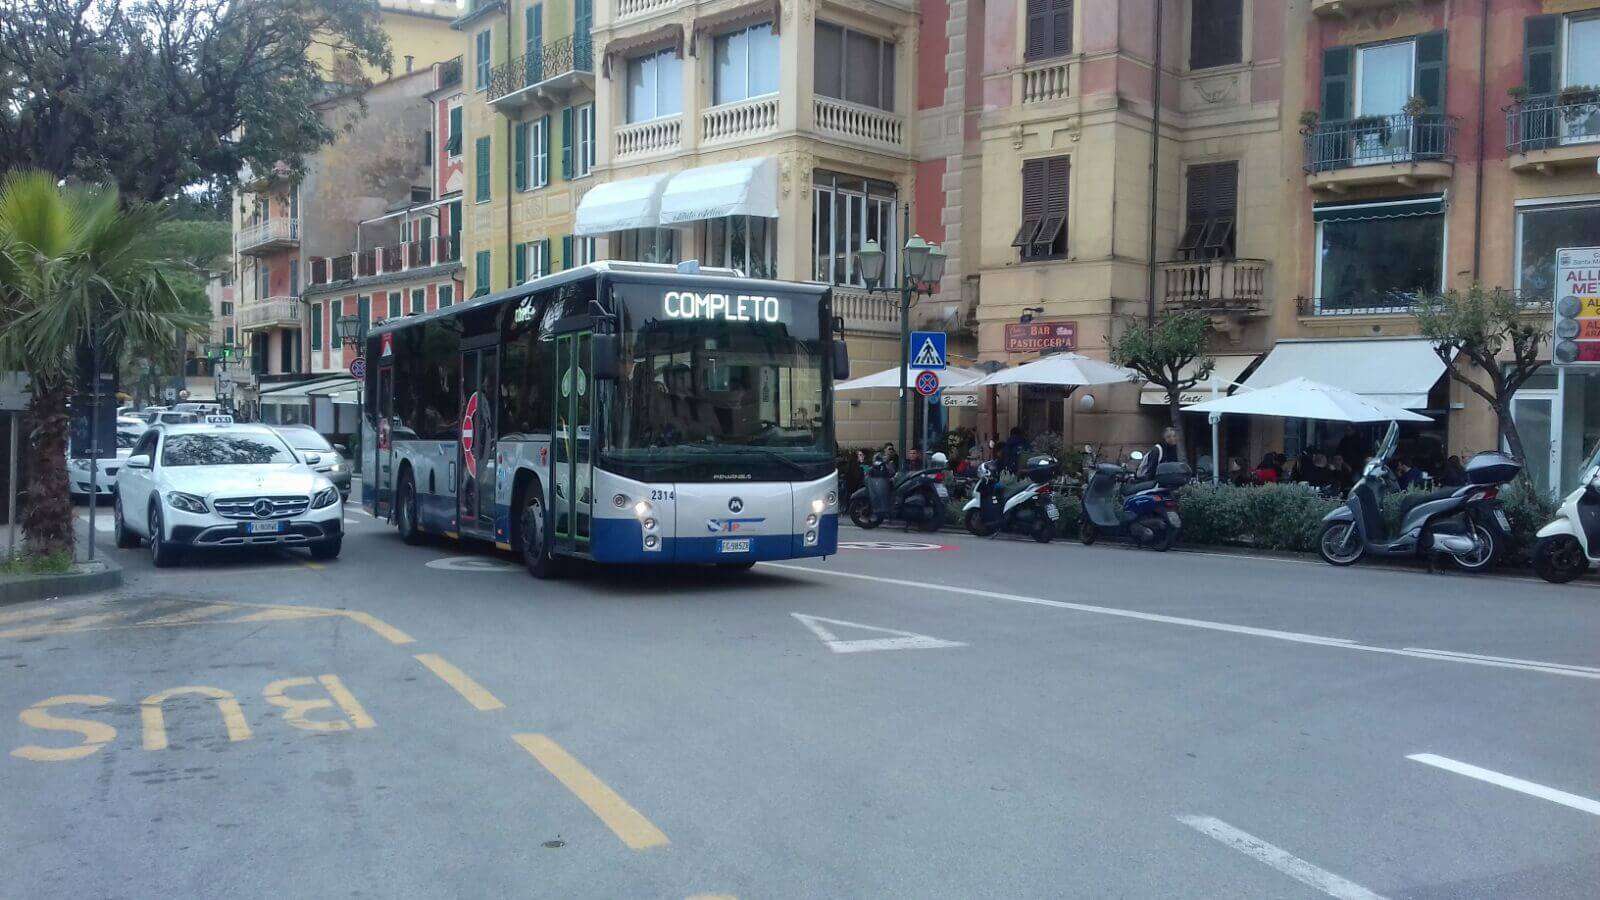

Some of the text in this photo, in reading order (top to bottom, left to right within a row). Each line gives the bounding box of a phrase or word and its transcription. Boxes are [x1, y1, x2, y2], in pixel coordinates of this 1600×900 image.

[1572, 282, 1600, 294] ME
[664, 291, 779, 322] COMPLETO
[1030, 326, 1050, 336] BAR
[1010, 338, 1071, 348] PASTICCERIA
[651, 490, 674, 501] 2314
[10, 674, 377, 761] BUS
